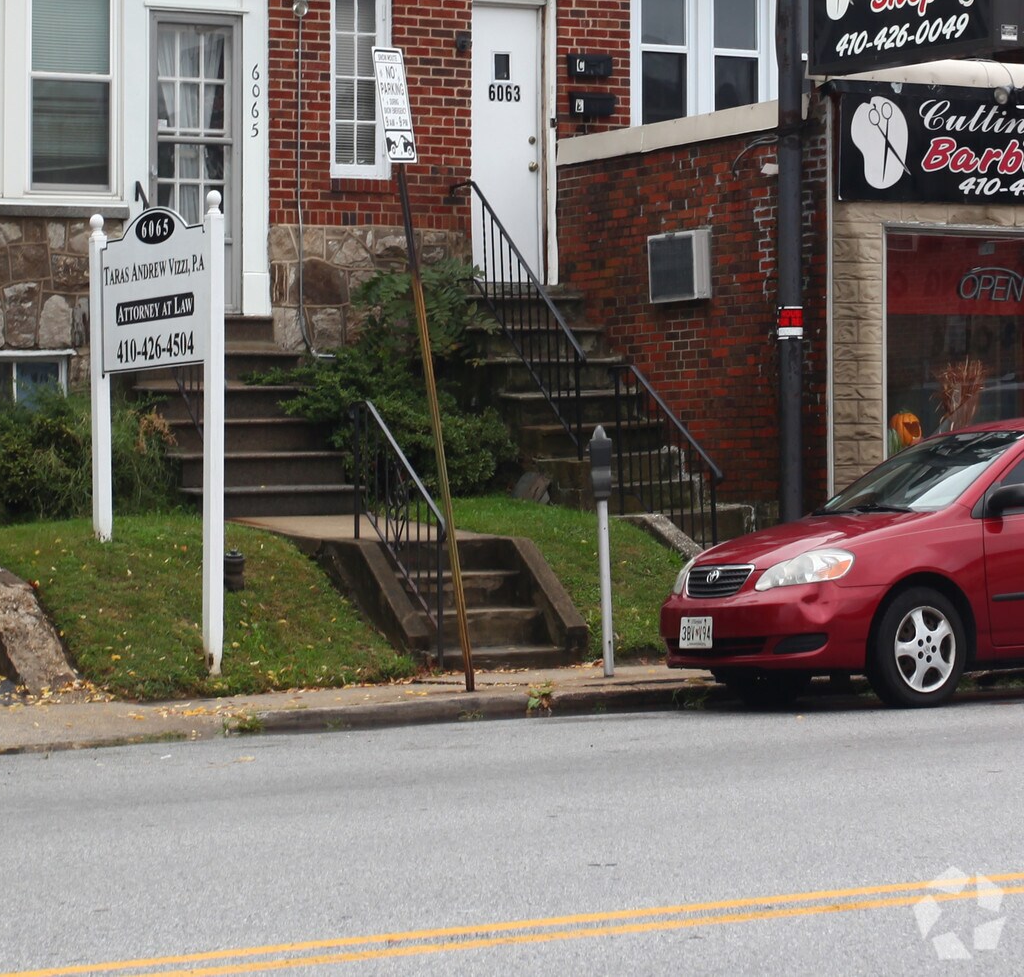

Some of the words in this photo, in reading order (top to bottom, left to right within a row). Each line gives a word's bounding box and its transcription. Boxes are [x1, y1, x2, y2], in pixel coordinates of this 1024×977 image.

[835, 13, 969, 57] 410-426-0049
[385, 65, 395, 79] NO
[251, 63, 260, 138] 6065
[380, 82, 405, 96] PARKING
[488, 84, 521, 102] 6063
[921, 137, 1024, 174] Barb
[958, 176, 1024, 196] 410-4
[141, 218, 169, 238] 6065
[104, 266, 129, 286] TARAS
[131, 260, 167, 282] ANDREW
[960, 274, 1024, 302] OPEN
[117, 303, 160, 323] ATTORNEY
[162, 303, 171, 316] AT
[174, 297, 193, 315] LAW
[117, 330, 194, 363] 410-426-4504
